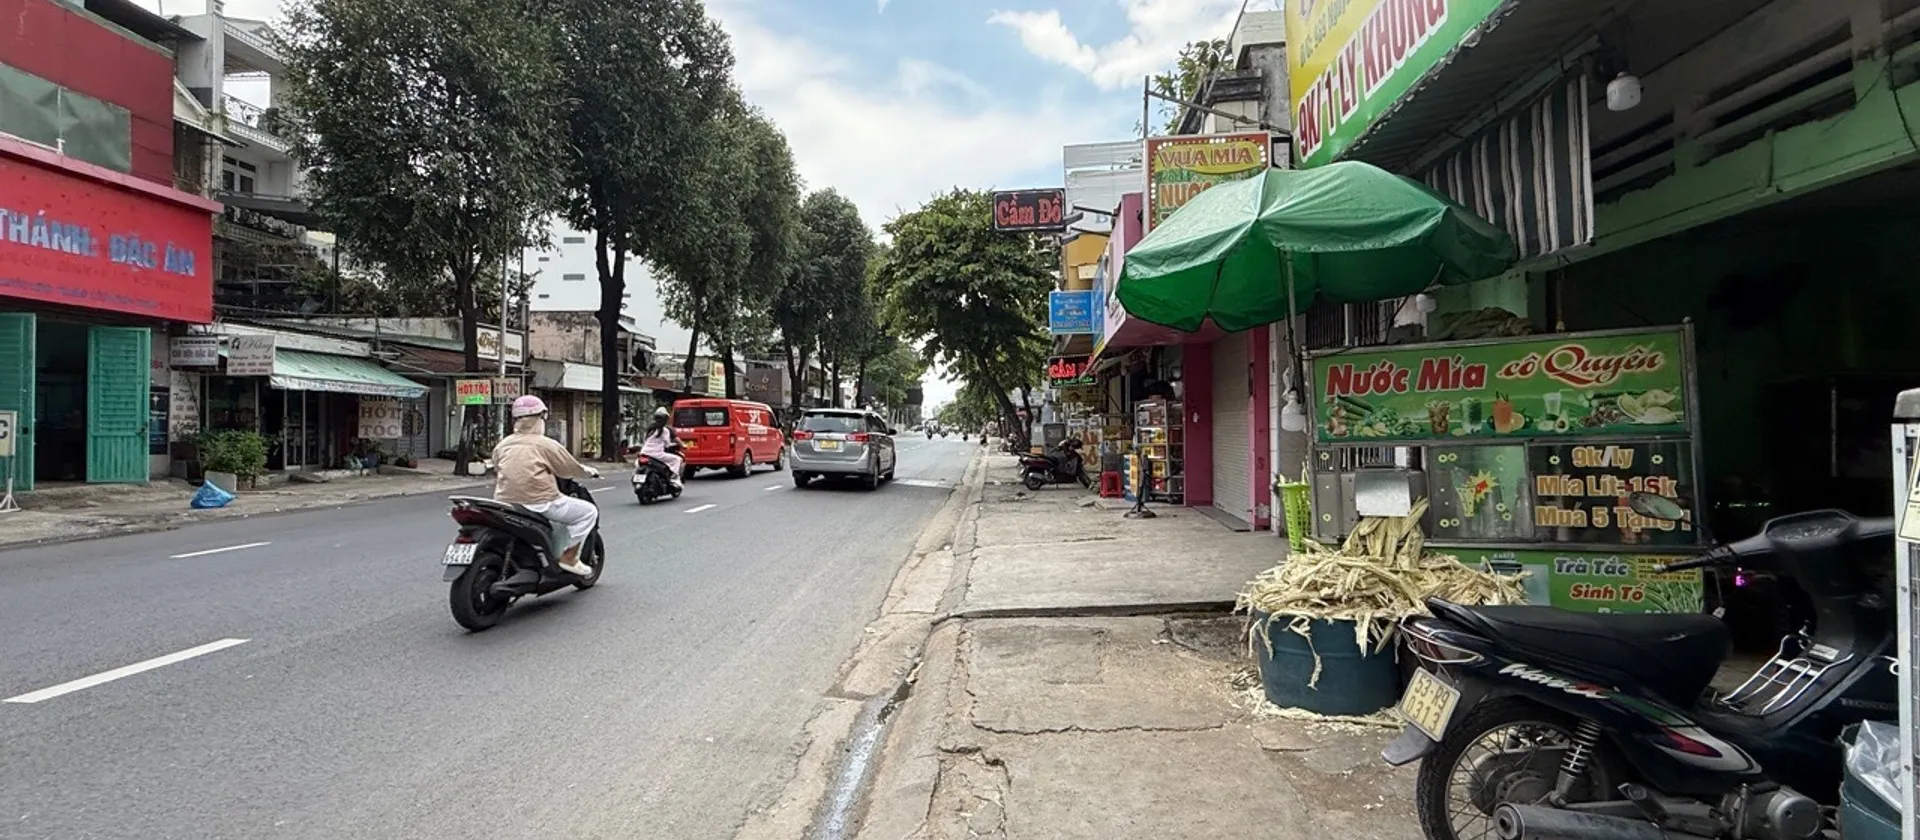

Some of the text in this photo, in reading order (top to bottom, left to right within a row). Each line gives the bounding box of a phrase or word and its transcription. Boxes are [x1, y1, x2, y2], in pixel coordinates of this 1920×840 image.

[1338, 37, 1357, 117] LY
[997, 192, 1062, 226] Cầm Đồ
[1326, 360, 1410, 398] Nước
[1416, 355, 1488, 392] Mía
[1497, 353, 1541, 379] cô
[1572, 446, 1634, 469] 9k/ly
[1536, 474, 1584, 496] Mía
[1586, 474, 1625, 496] Lít:
[1592, 506, 1609, 528] 5
[1555, 556, 1589, 575] Trà
[1592, 555, 1629, 576] Tắc
[1571, 583, 1646, 602] Sinh Tố
[1406, 696, 1440, 731] 0313
